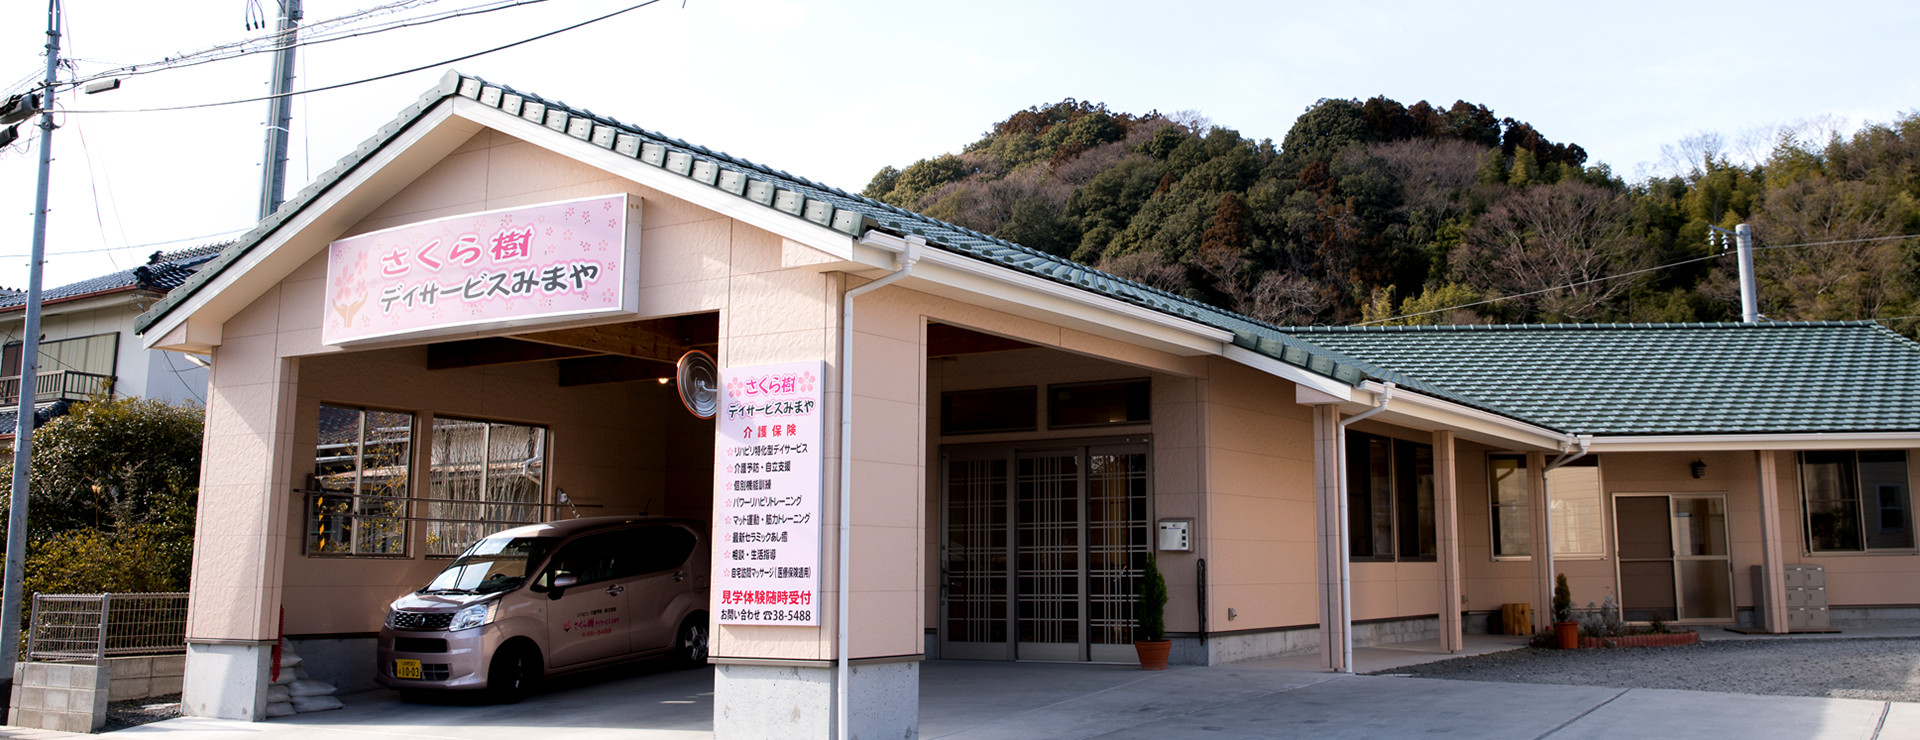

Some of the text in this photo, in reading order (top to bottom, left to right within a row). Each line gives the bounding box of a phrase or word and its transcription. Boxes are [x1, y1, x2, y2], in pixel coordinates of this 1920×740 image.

[382, 228, 533, 276] さくら樹
[380, 263, 599, 312] デイサービスみまや
[746, 375, 796, 395] さくら樹
[728, 399, 814, 419] デイサービスみまや
[733, 443, 808, 457] リハビリ特化型デイサービス
[733, 460, 791, 474] 介護予防・自立支援
[733, 479, 772, 491] 個別機能訓練
[732, 494, 803, 508] パワーリハビリトレーニング
[732, 512, 811, 526] マット運動・筋力トレーニング
[732, 548, 777, 561] 相談・生活指導
[721, 590, 812, 605] 見学体験随時受付
[720, 609, 761, 621] お問い合わせ
[402, 666, 420, 678] 10-03
